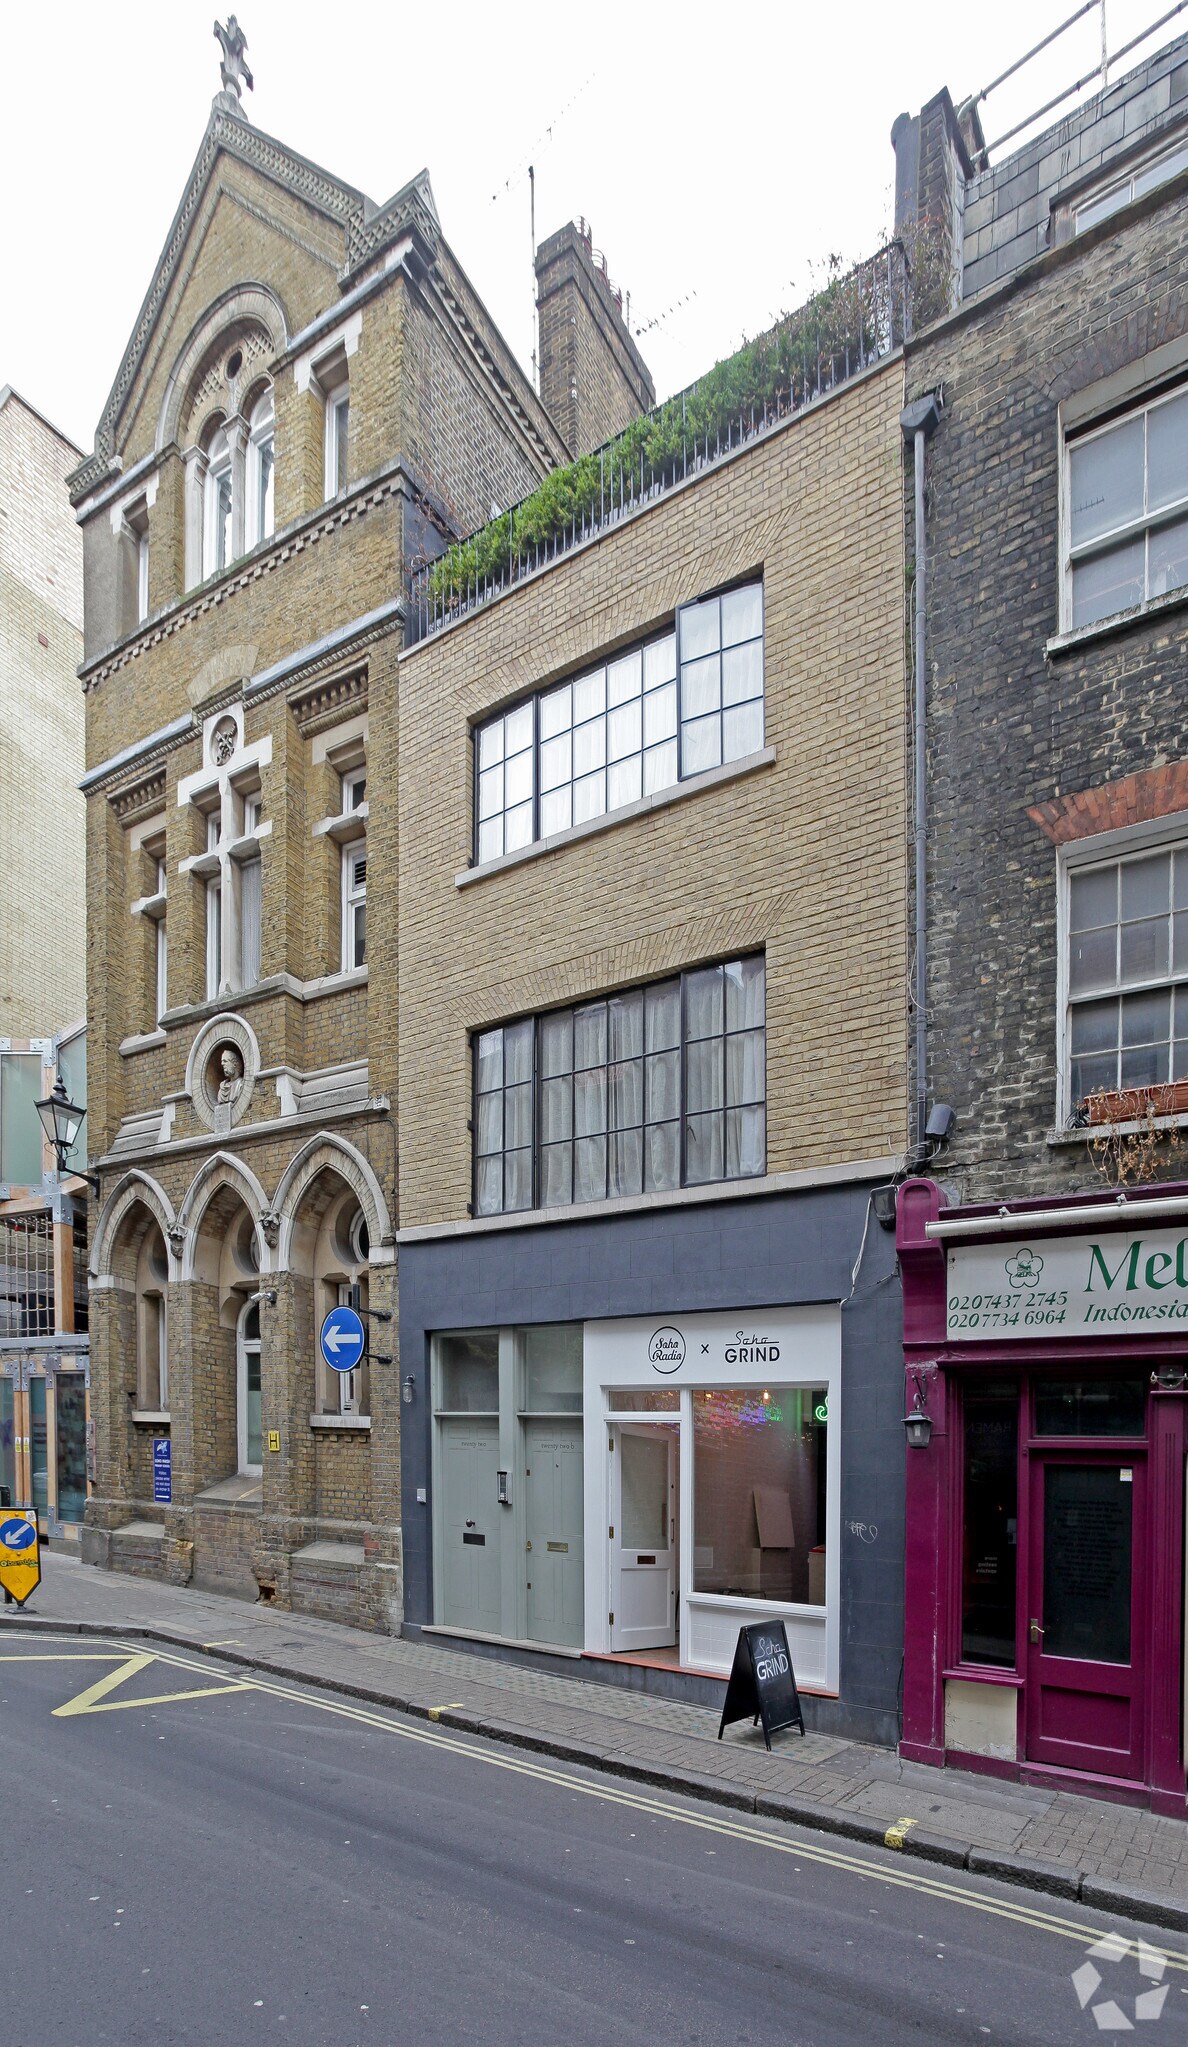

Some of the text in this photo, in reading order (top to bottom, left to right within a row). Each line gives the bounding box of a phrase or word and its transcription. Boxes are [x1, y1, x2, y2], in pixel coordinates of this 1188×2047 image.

[1025, 1291, 1068, 1307] 2745
[1024, 1309, 1066, 1326] 6964
[655, 1337, 679, 1350] Soho
[725, 1330, 780, 1346] Soho
[652, 1349, 682, 1362] Radio
[724, 1346, 780, 1363] GRIND
[756, 1653, 789, 1680] GRIND
